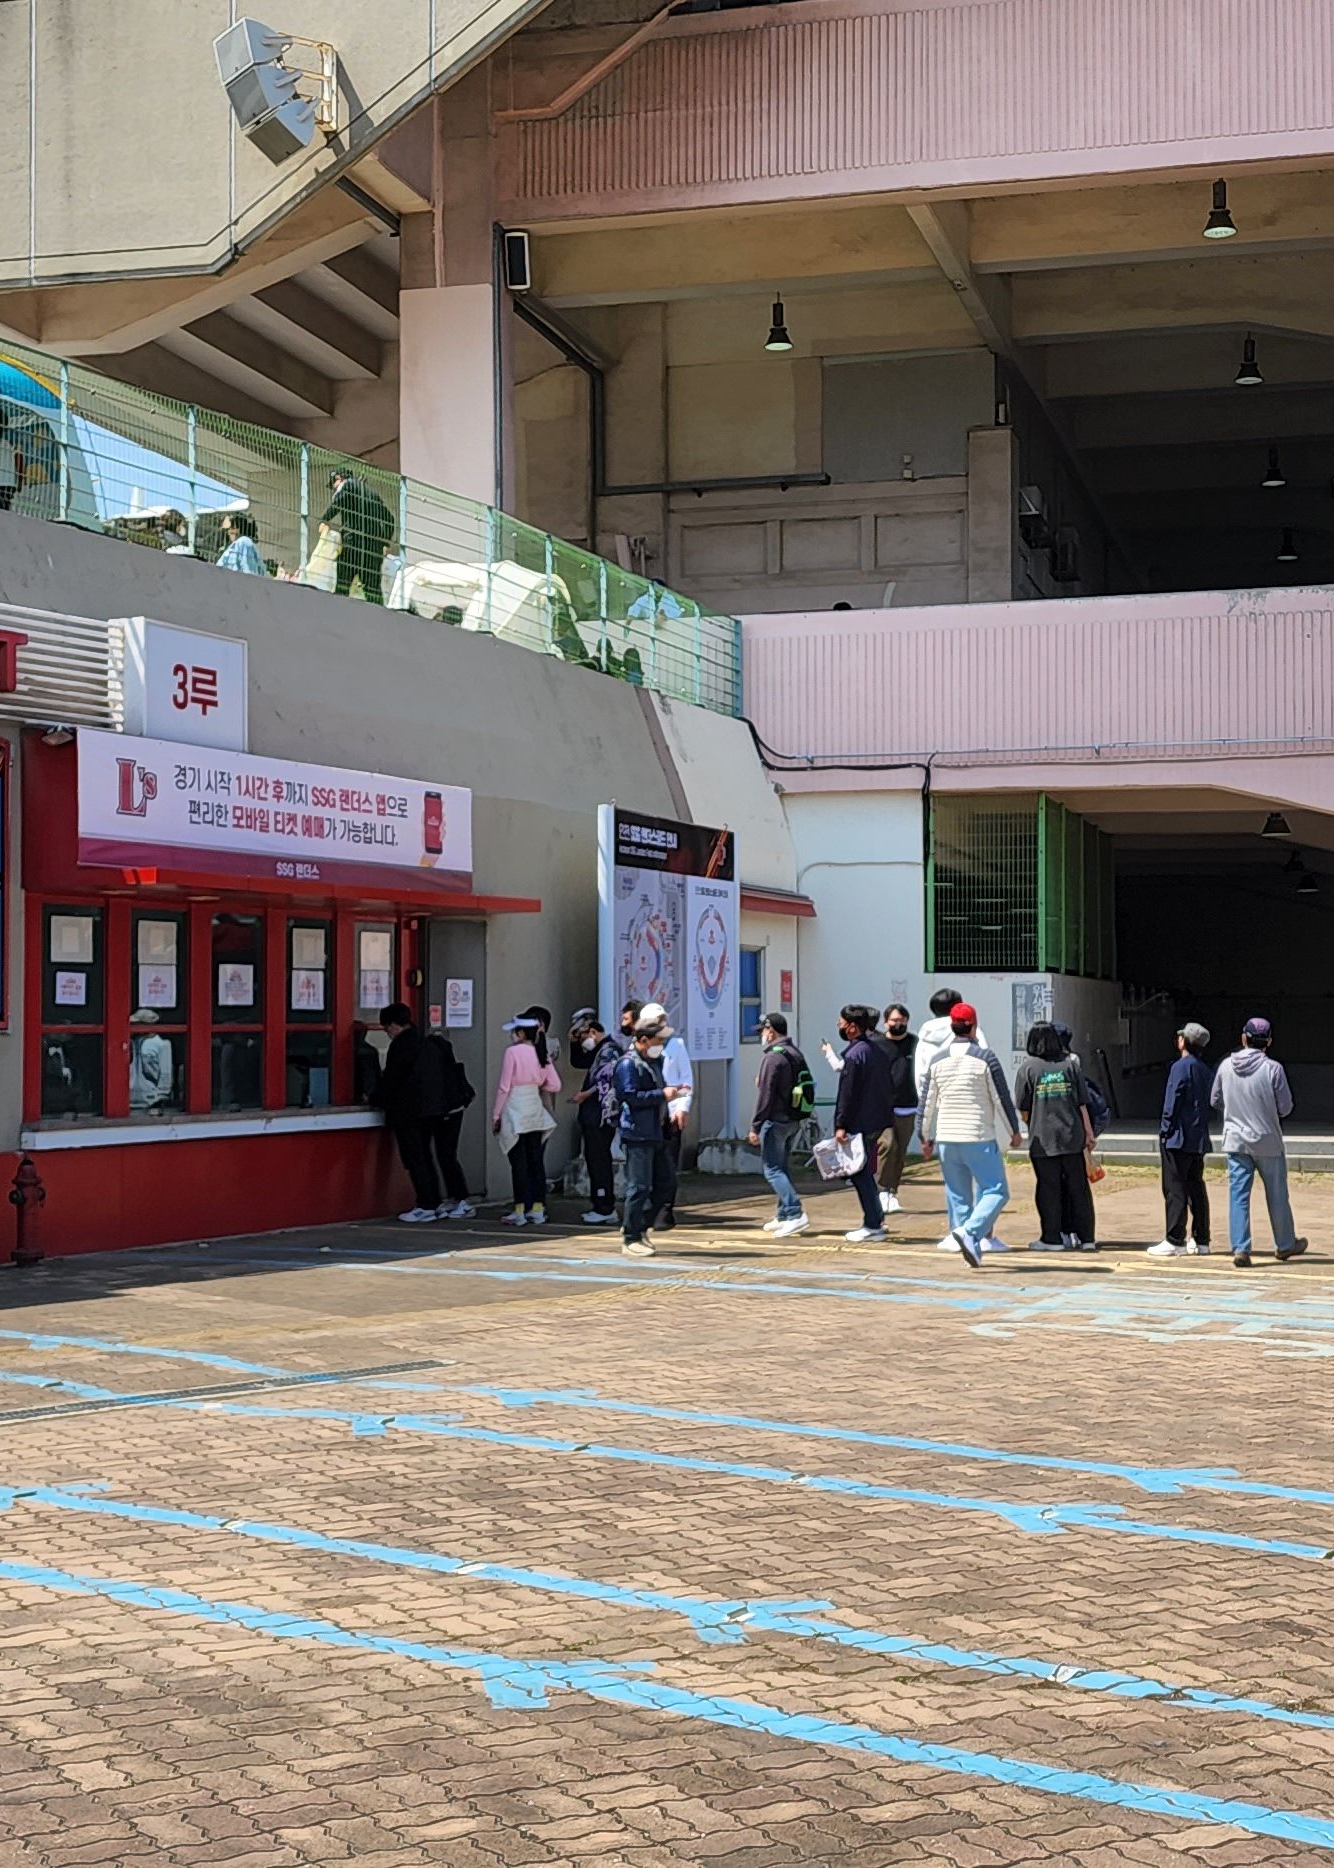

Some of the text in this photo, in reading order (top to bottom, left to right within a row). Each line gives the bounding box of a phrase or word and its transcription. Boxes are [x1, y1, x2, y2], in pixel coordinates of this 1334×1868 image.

[173, 663, 218, 716] 3루
[173, 764, 409, 819] 경기 시작 1시간 후까지 SSG 랜더스 앱으로
[187, 800, 399, 847] 편리한 모바일 티켓 예매가 가능합니다.
[276, 861, 320, 880] SSG 랜더스
